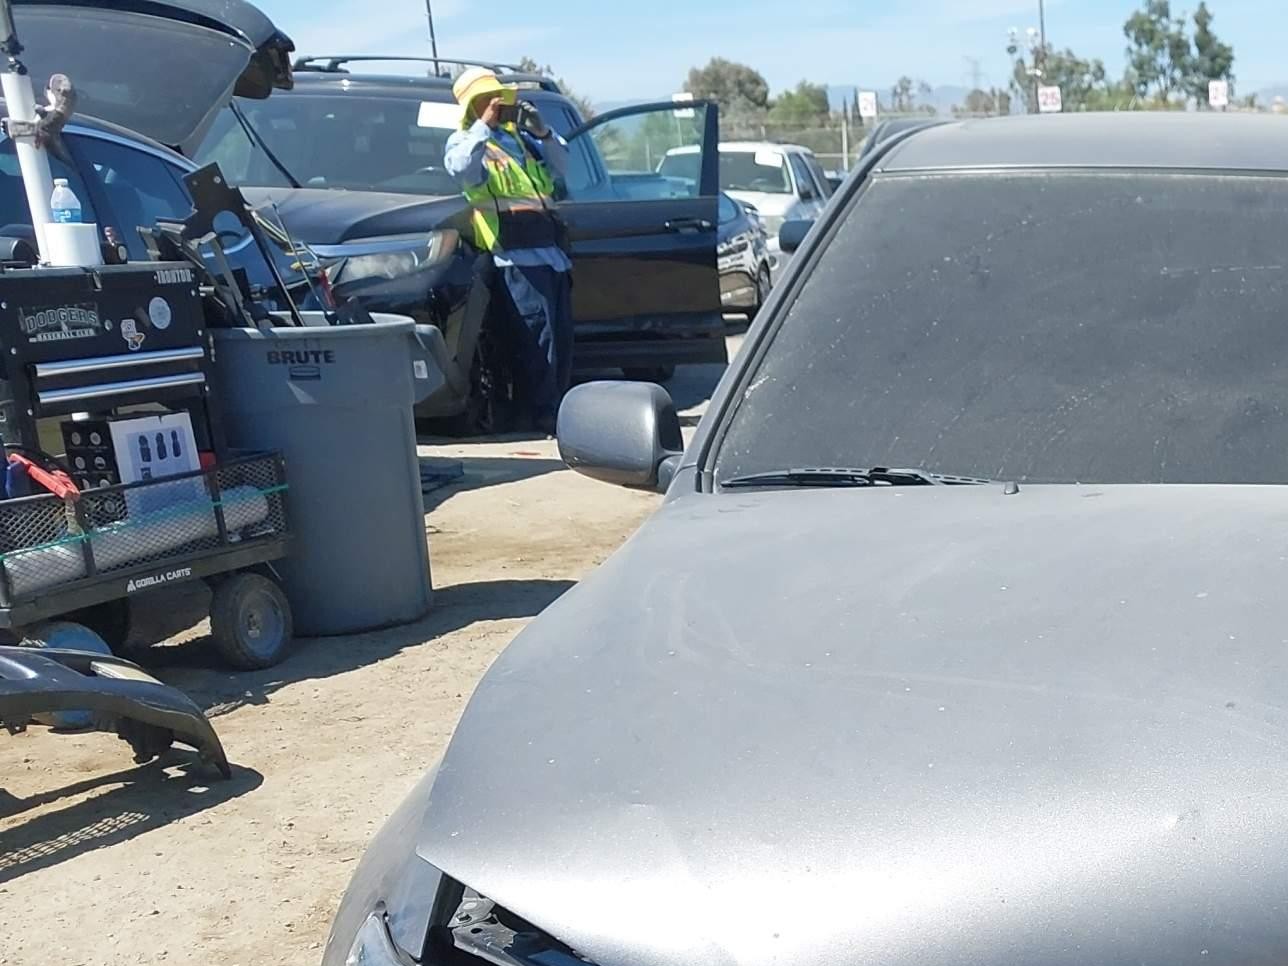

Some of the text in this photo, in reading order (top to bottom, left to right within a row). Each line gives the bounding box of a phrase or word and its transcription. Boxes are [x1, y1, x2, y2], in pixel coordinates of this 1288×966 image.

[25, 308, 98, 334] DODGERS
[266, 349, 336, 365] BRUTE
[135, 568, 191, 589] GORILLA CARTS
